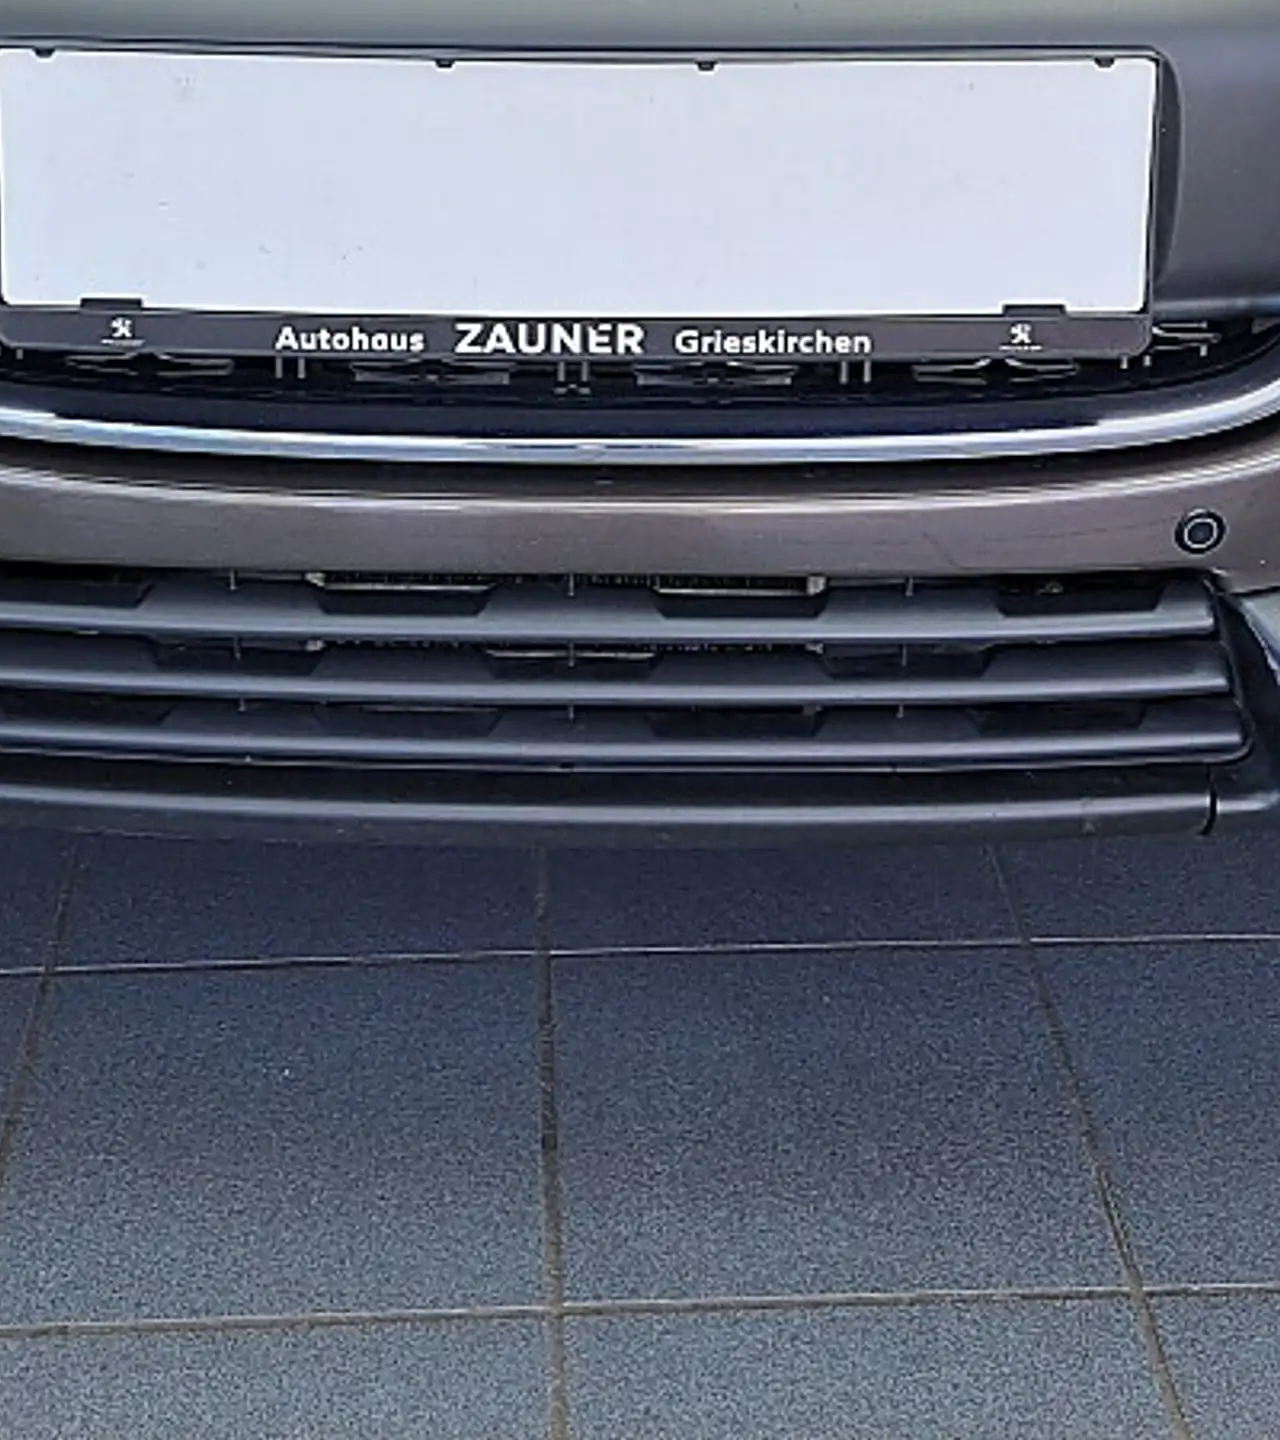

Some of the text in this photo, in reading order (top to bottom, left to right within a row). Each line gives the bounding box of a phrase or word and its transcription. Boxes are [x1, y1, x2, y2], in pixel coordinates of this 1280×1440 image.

[274, 322, 872, 355] Autohaus ZAUNER Grieskirchen
